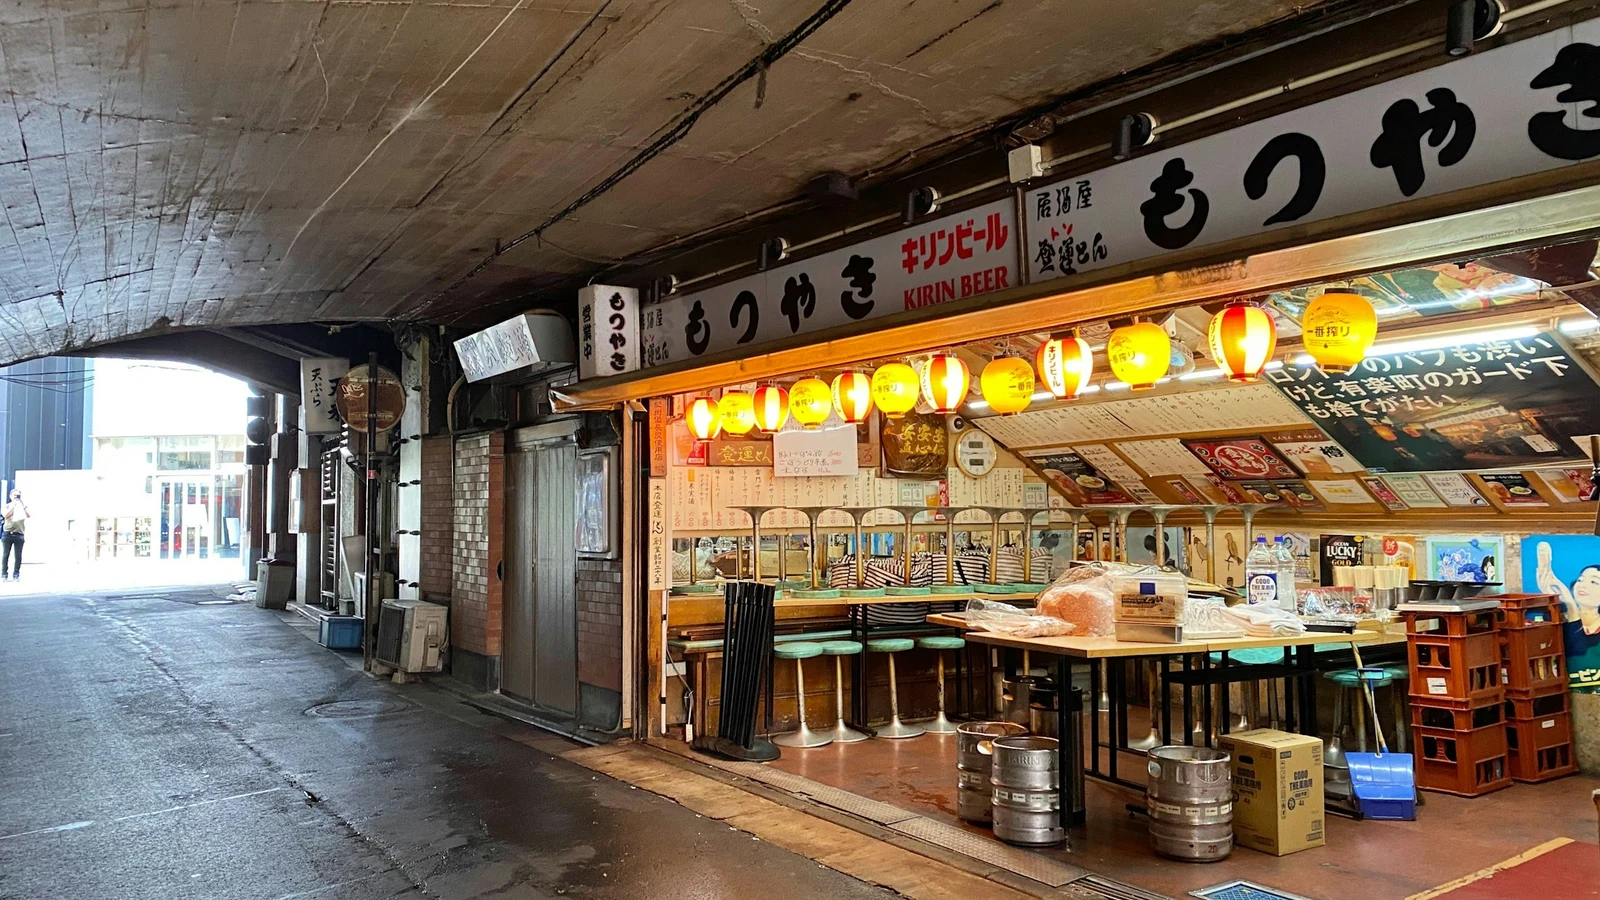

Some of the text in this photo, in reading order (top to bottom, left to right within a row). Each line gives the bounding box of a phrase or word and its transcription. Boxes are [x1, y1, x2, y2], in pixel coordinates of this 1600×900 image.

[1140, 42, 1600, 249] もつやき
[1037, 180, 1092, 221] 居酒屋
[901, 212, 1008, 274] キリンビール
[1034, 232, 1108, 275] 登運とん
[685, 254, 876, 356] もつやき
[903, 266, 1009, 312] KIRIN BEER
[582, 303, 592, 360] 営業中
[609, 292, 627, 371] もつやき
[1306, 325, 1350, 338] 一番搾り
[1008, 382, 1035, 391] 一番搾
[1048, 345, 1061, 387] キリンビール
[1284, 354, 1569, 402] けど、有楽町のガード下
[310, 367, 323, 407] 天ぷら
[718, 444, 772, 464] 登運とん
[1326, 545, 1357, 558] LUCKY
[1385, 539, 1396, 550] 新
[1008, 754, 1040, 765] KIRIN
[1293, 770, 1309, 780] GOOD
[1207, 845, 1219, 854] 20
